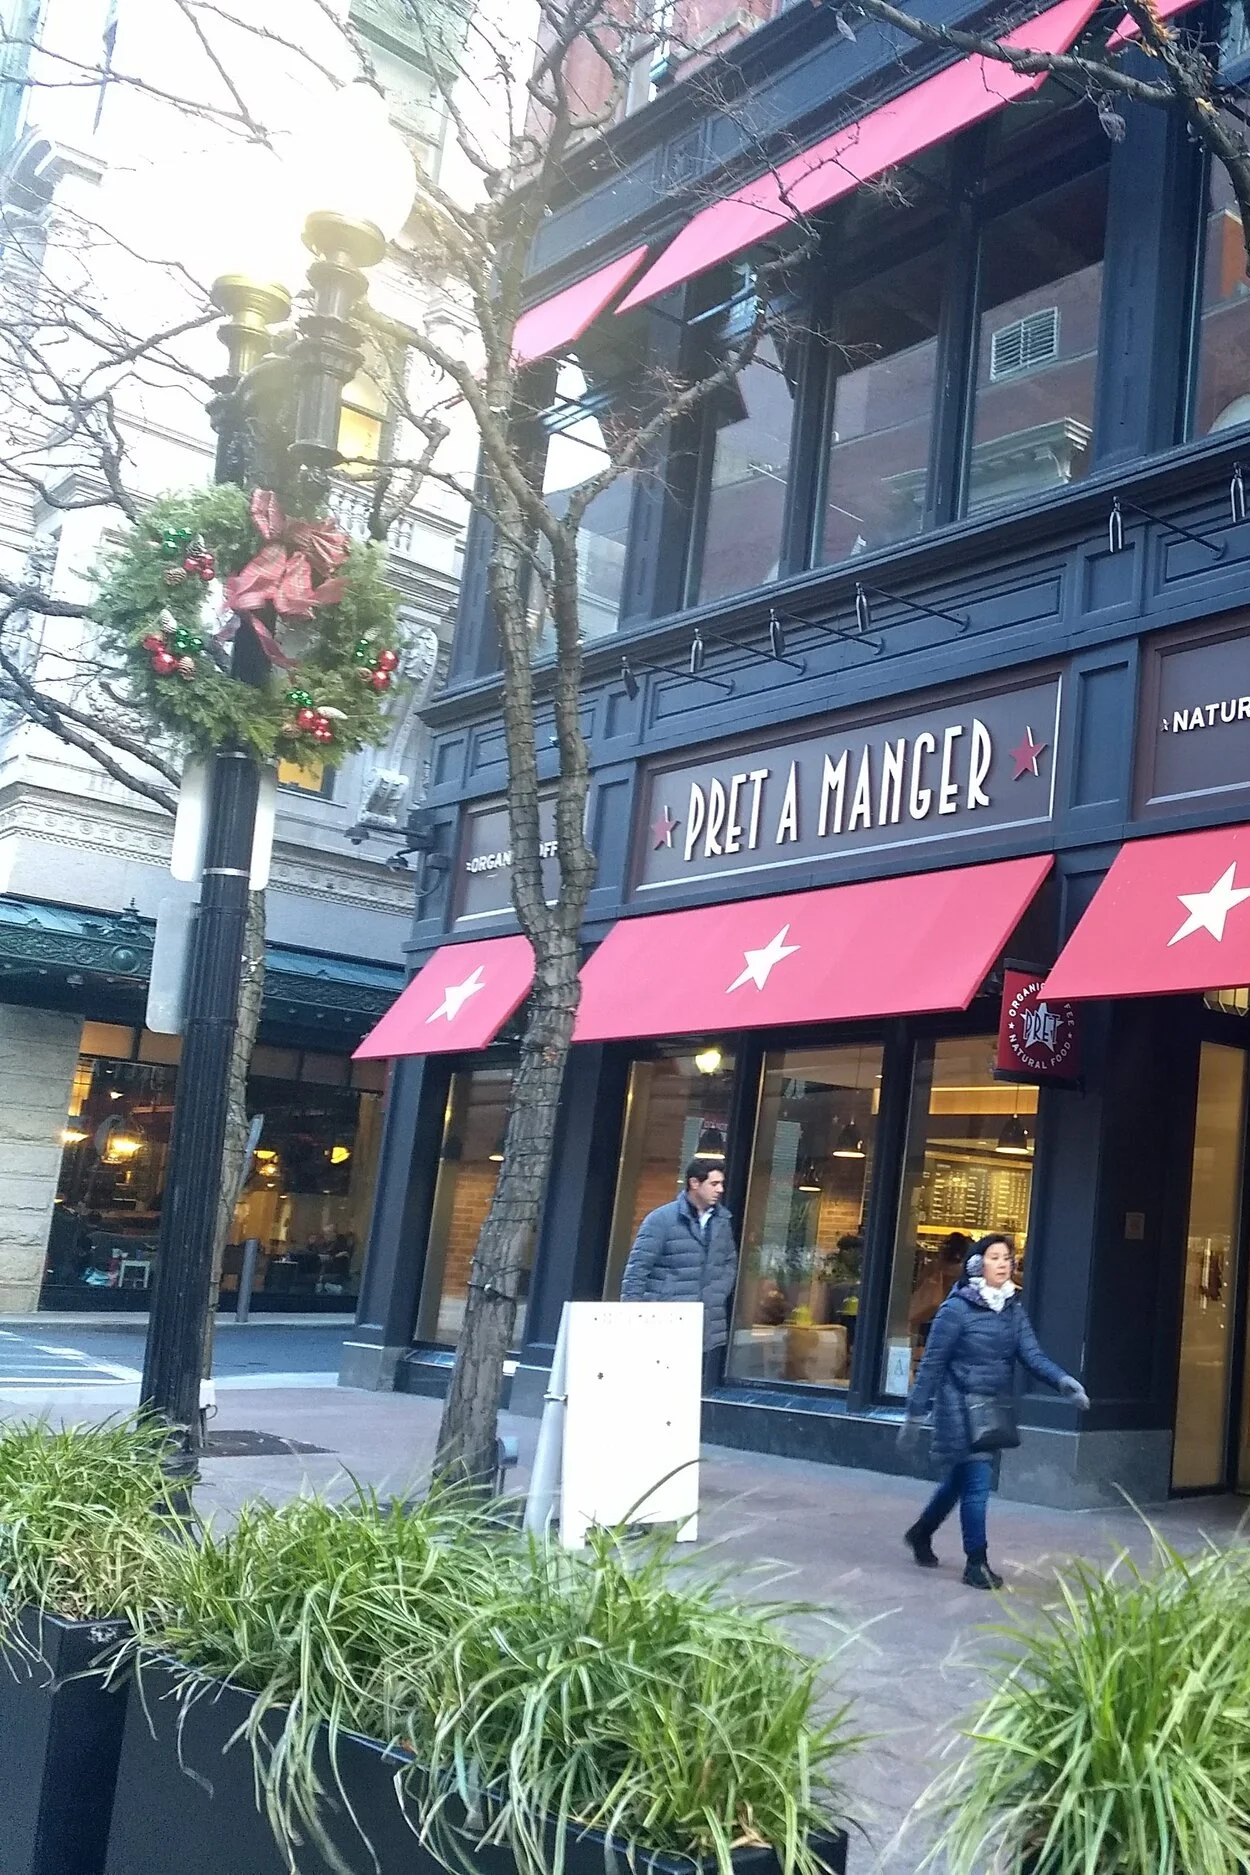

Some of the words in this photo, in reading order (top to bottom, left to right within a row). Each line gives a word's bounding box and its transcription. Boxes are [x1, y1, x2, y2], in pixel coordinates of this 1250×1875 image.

[684, 768, 768, 861] PRET
[776, 760, 797, 844] A
[817, 718, 992, 836] MANGER
[470, 850, 512, 873] ORGAN
[1023, 1008, 1060, 1044] PRET
[1008, 1034, 1048, 1069] NATURAL
[1050, 1042, 1071, 1067] FOOD
